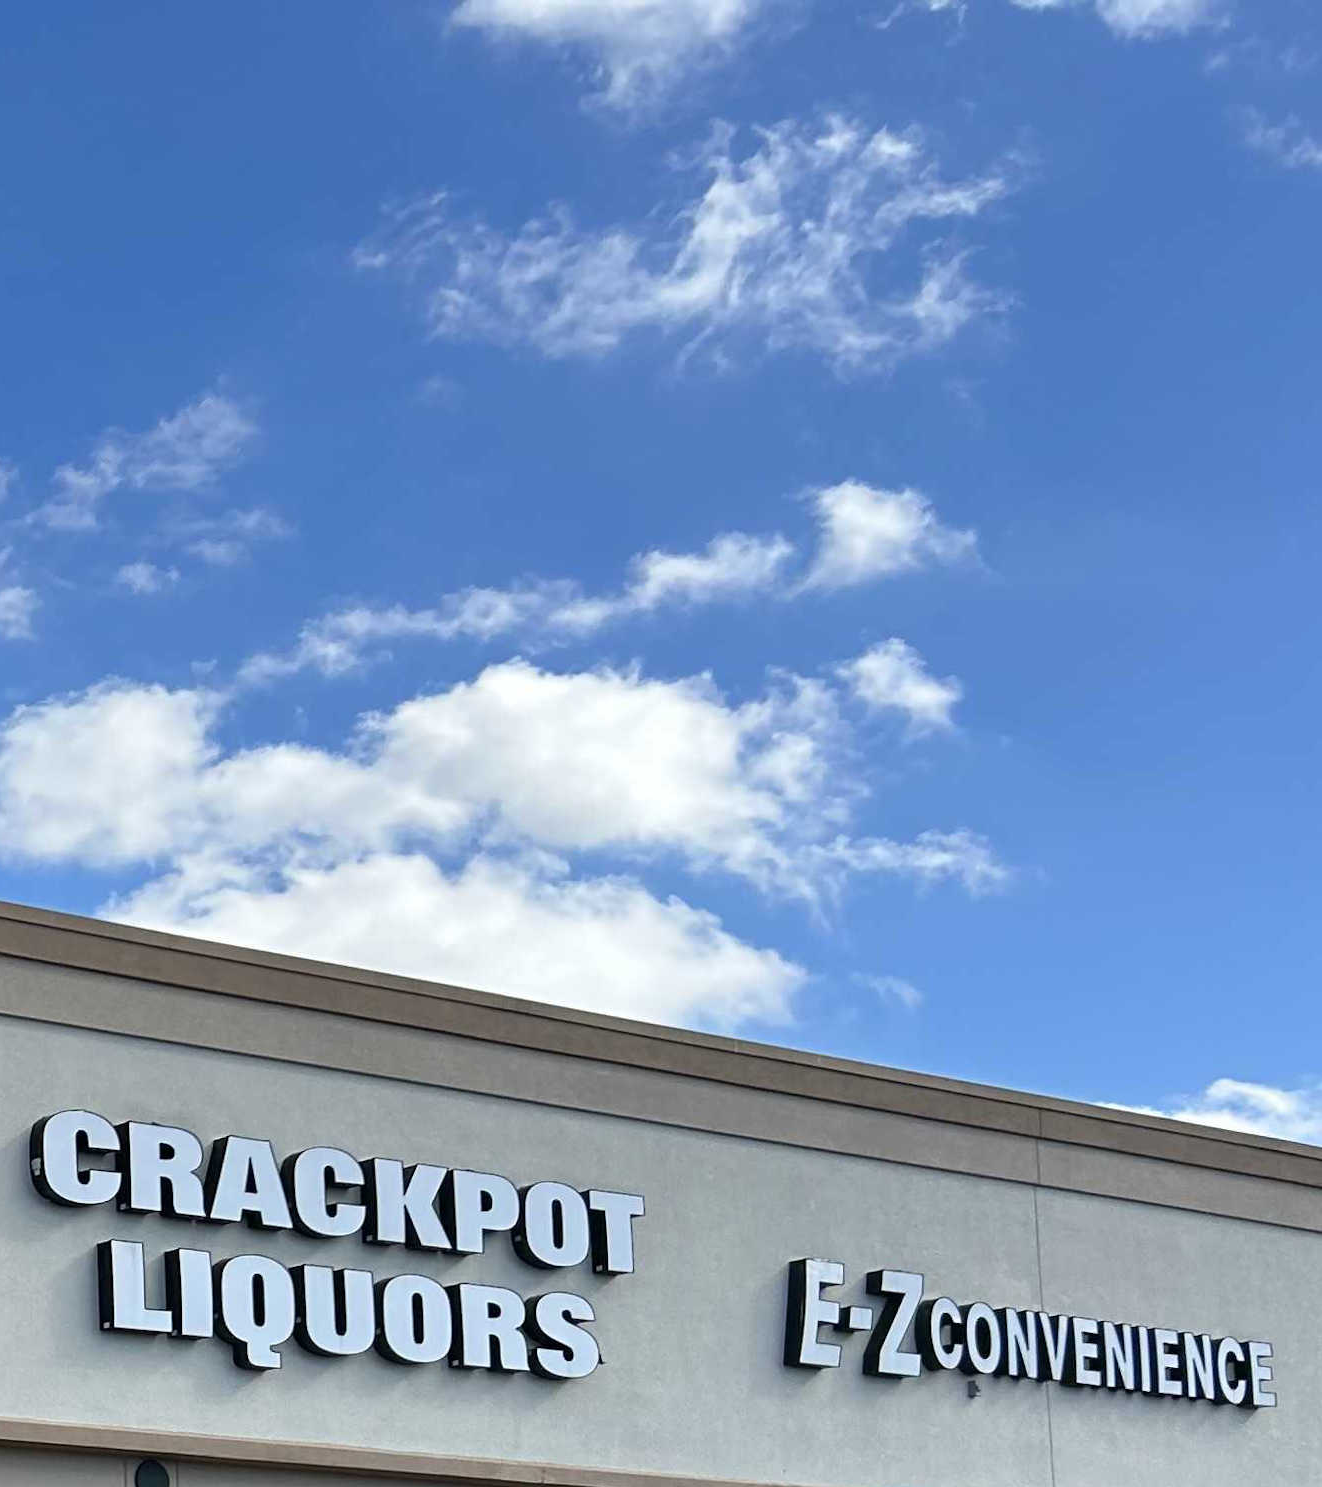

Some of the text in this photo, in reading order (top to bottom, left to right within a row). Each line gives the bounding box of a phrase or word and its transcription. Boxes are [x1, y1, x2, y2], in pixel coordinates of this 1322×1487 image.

[31, 1108, 646, 1275] CRACKPOT
[99, 1238, 603, 1379] LIQUORS
[784, 1258, 1278, 1408] E-Z CONVENIENCE
